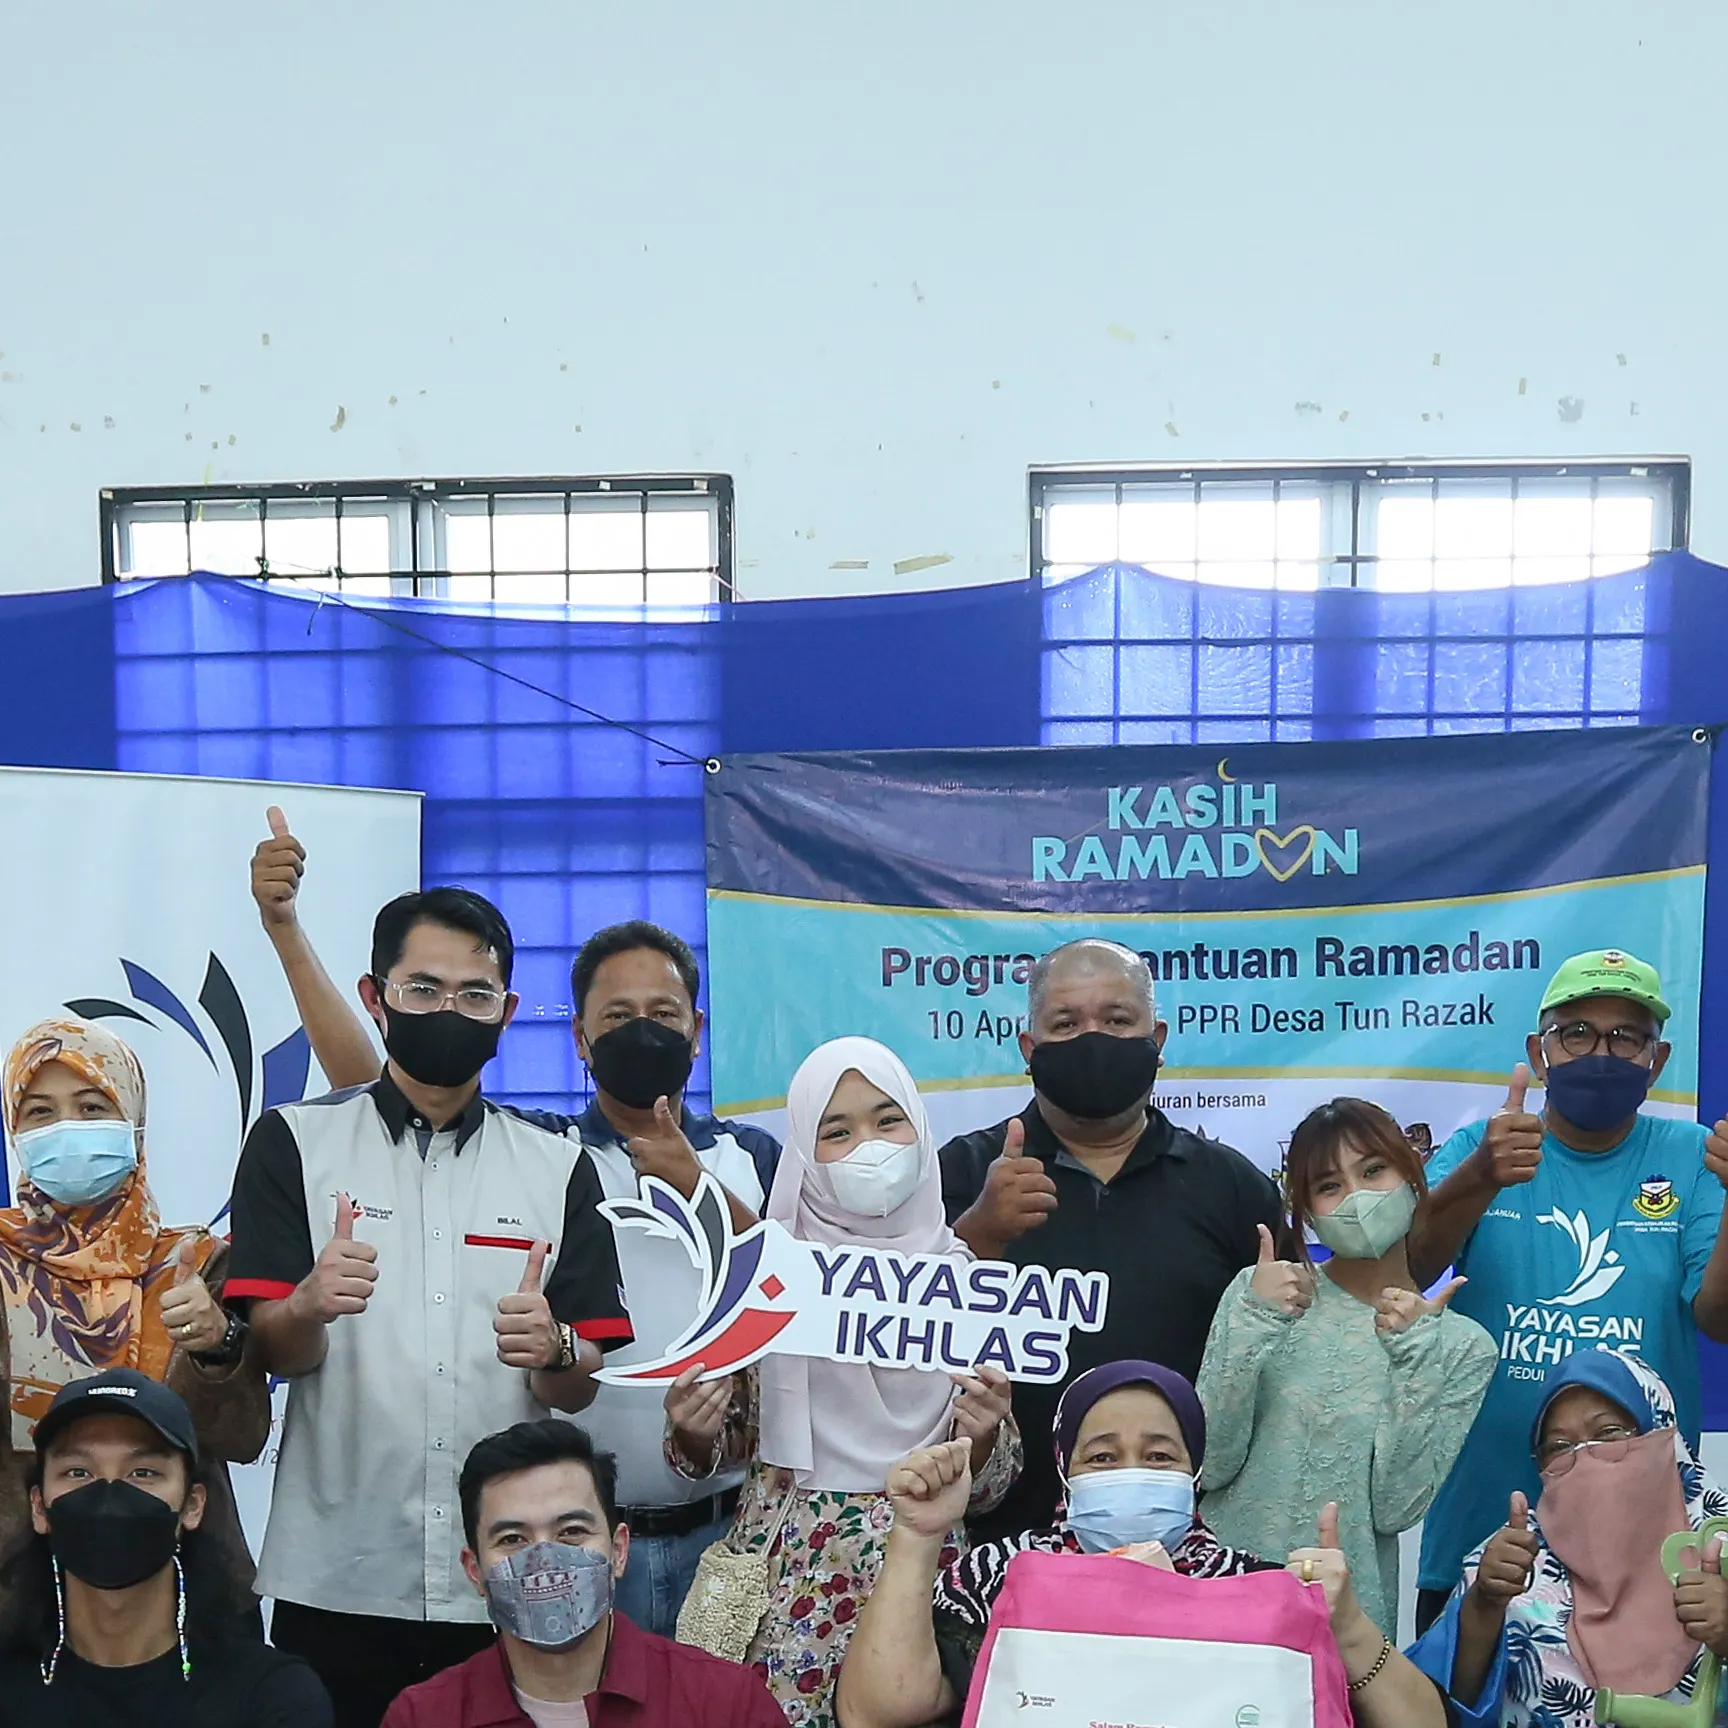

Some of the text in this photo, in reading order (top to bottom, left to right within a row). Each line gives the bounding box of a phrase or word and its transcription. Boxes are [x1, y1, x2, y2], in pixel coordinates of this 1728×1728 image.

[1107, 783, 1277, 830] KASIH
[881, 930, 1541, 996] Progra antuan Ramadan
[927, 993, 1495, 1046] 10 Apr PPR Desa Tun Razak
[1196, 1090, 1266, 1110] bersama
[812, 1249, 1101, 1325] YAYASAN
[835, 1310, 1062, 1377] IKHLAS
[1505, 1303, 1644, 1341] YAYASAN
